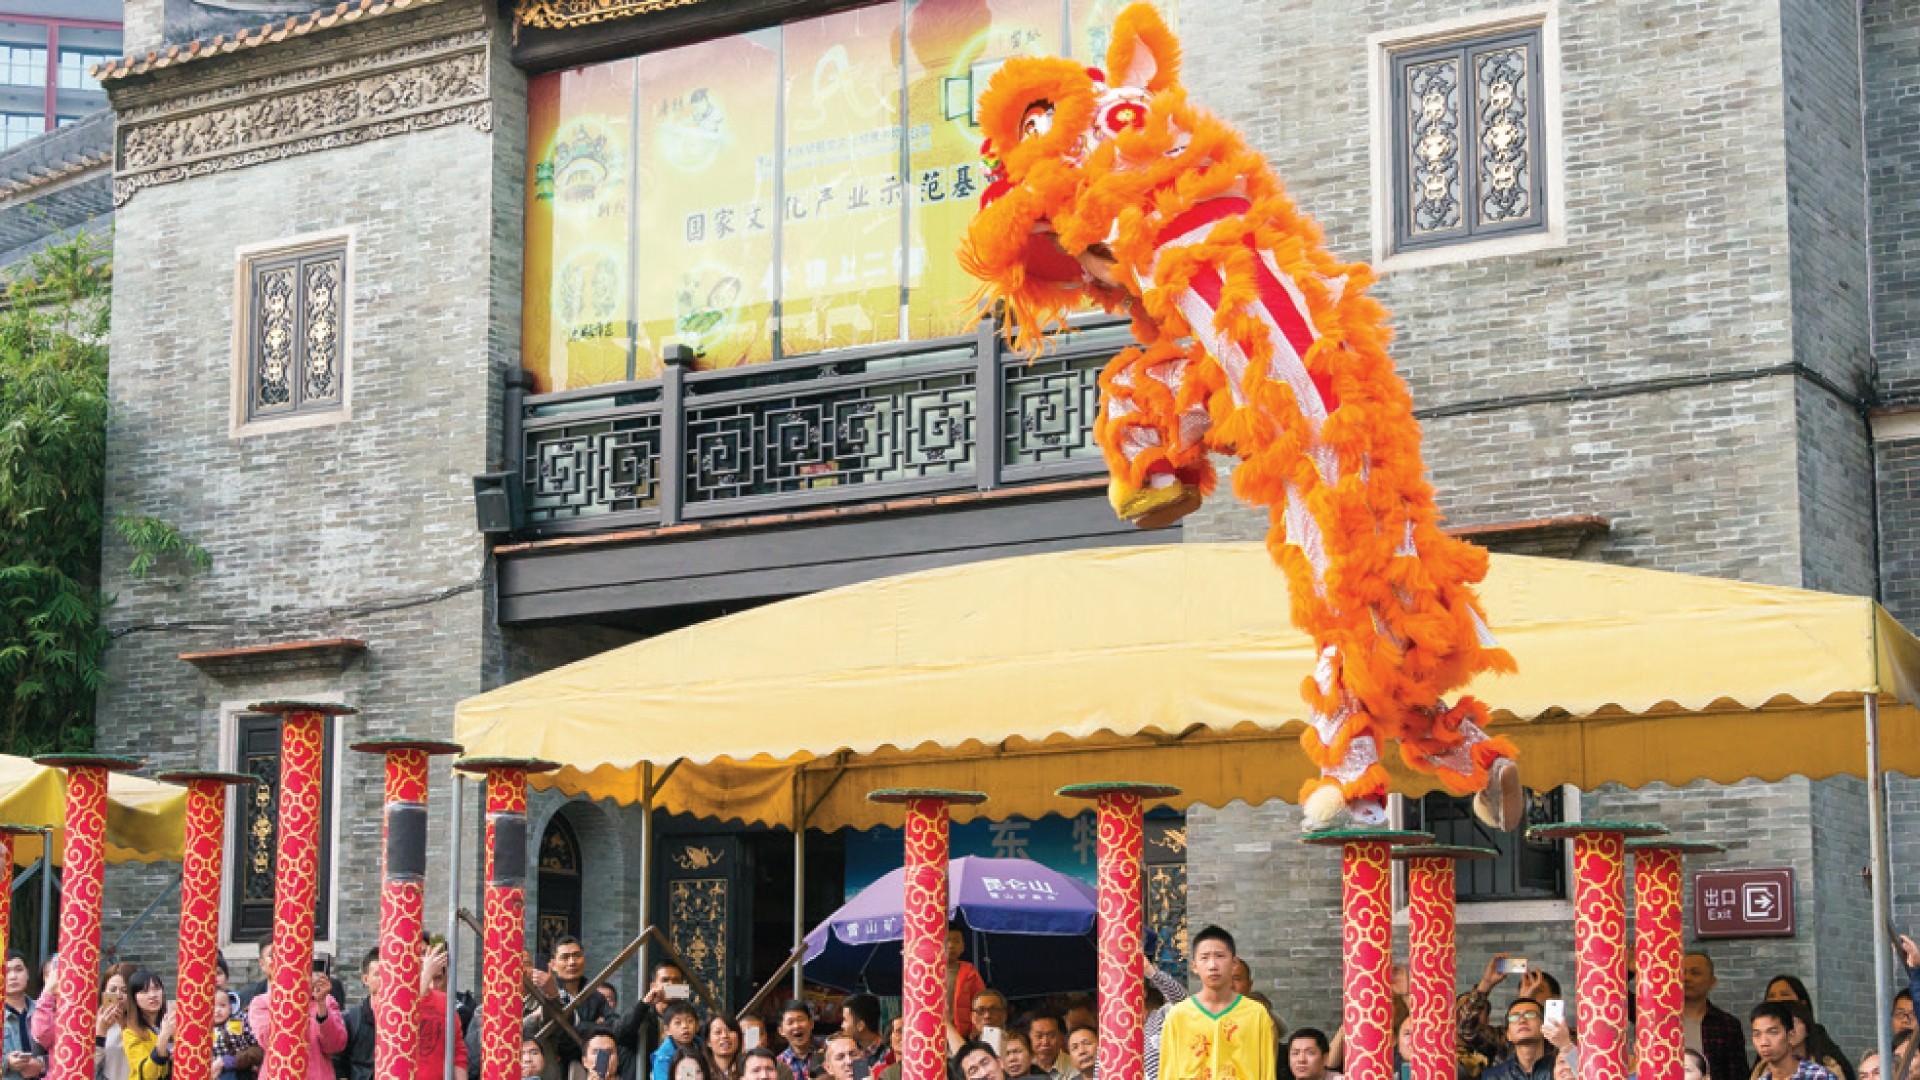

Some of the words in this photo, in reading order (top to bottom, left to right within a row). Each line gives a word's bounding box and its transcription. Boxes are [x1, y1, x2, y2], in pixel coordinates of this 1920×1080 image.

[686, 164, 996, 242] 国家文化产业示范基
[982, 876, 1053, 893] 昆仑山
[1704, 888, 1736, 907] 出口
[1707, 908, 1732, 920] Exit
